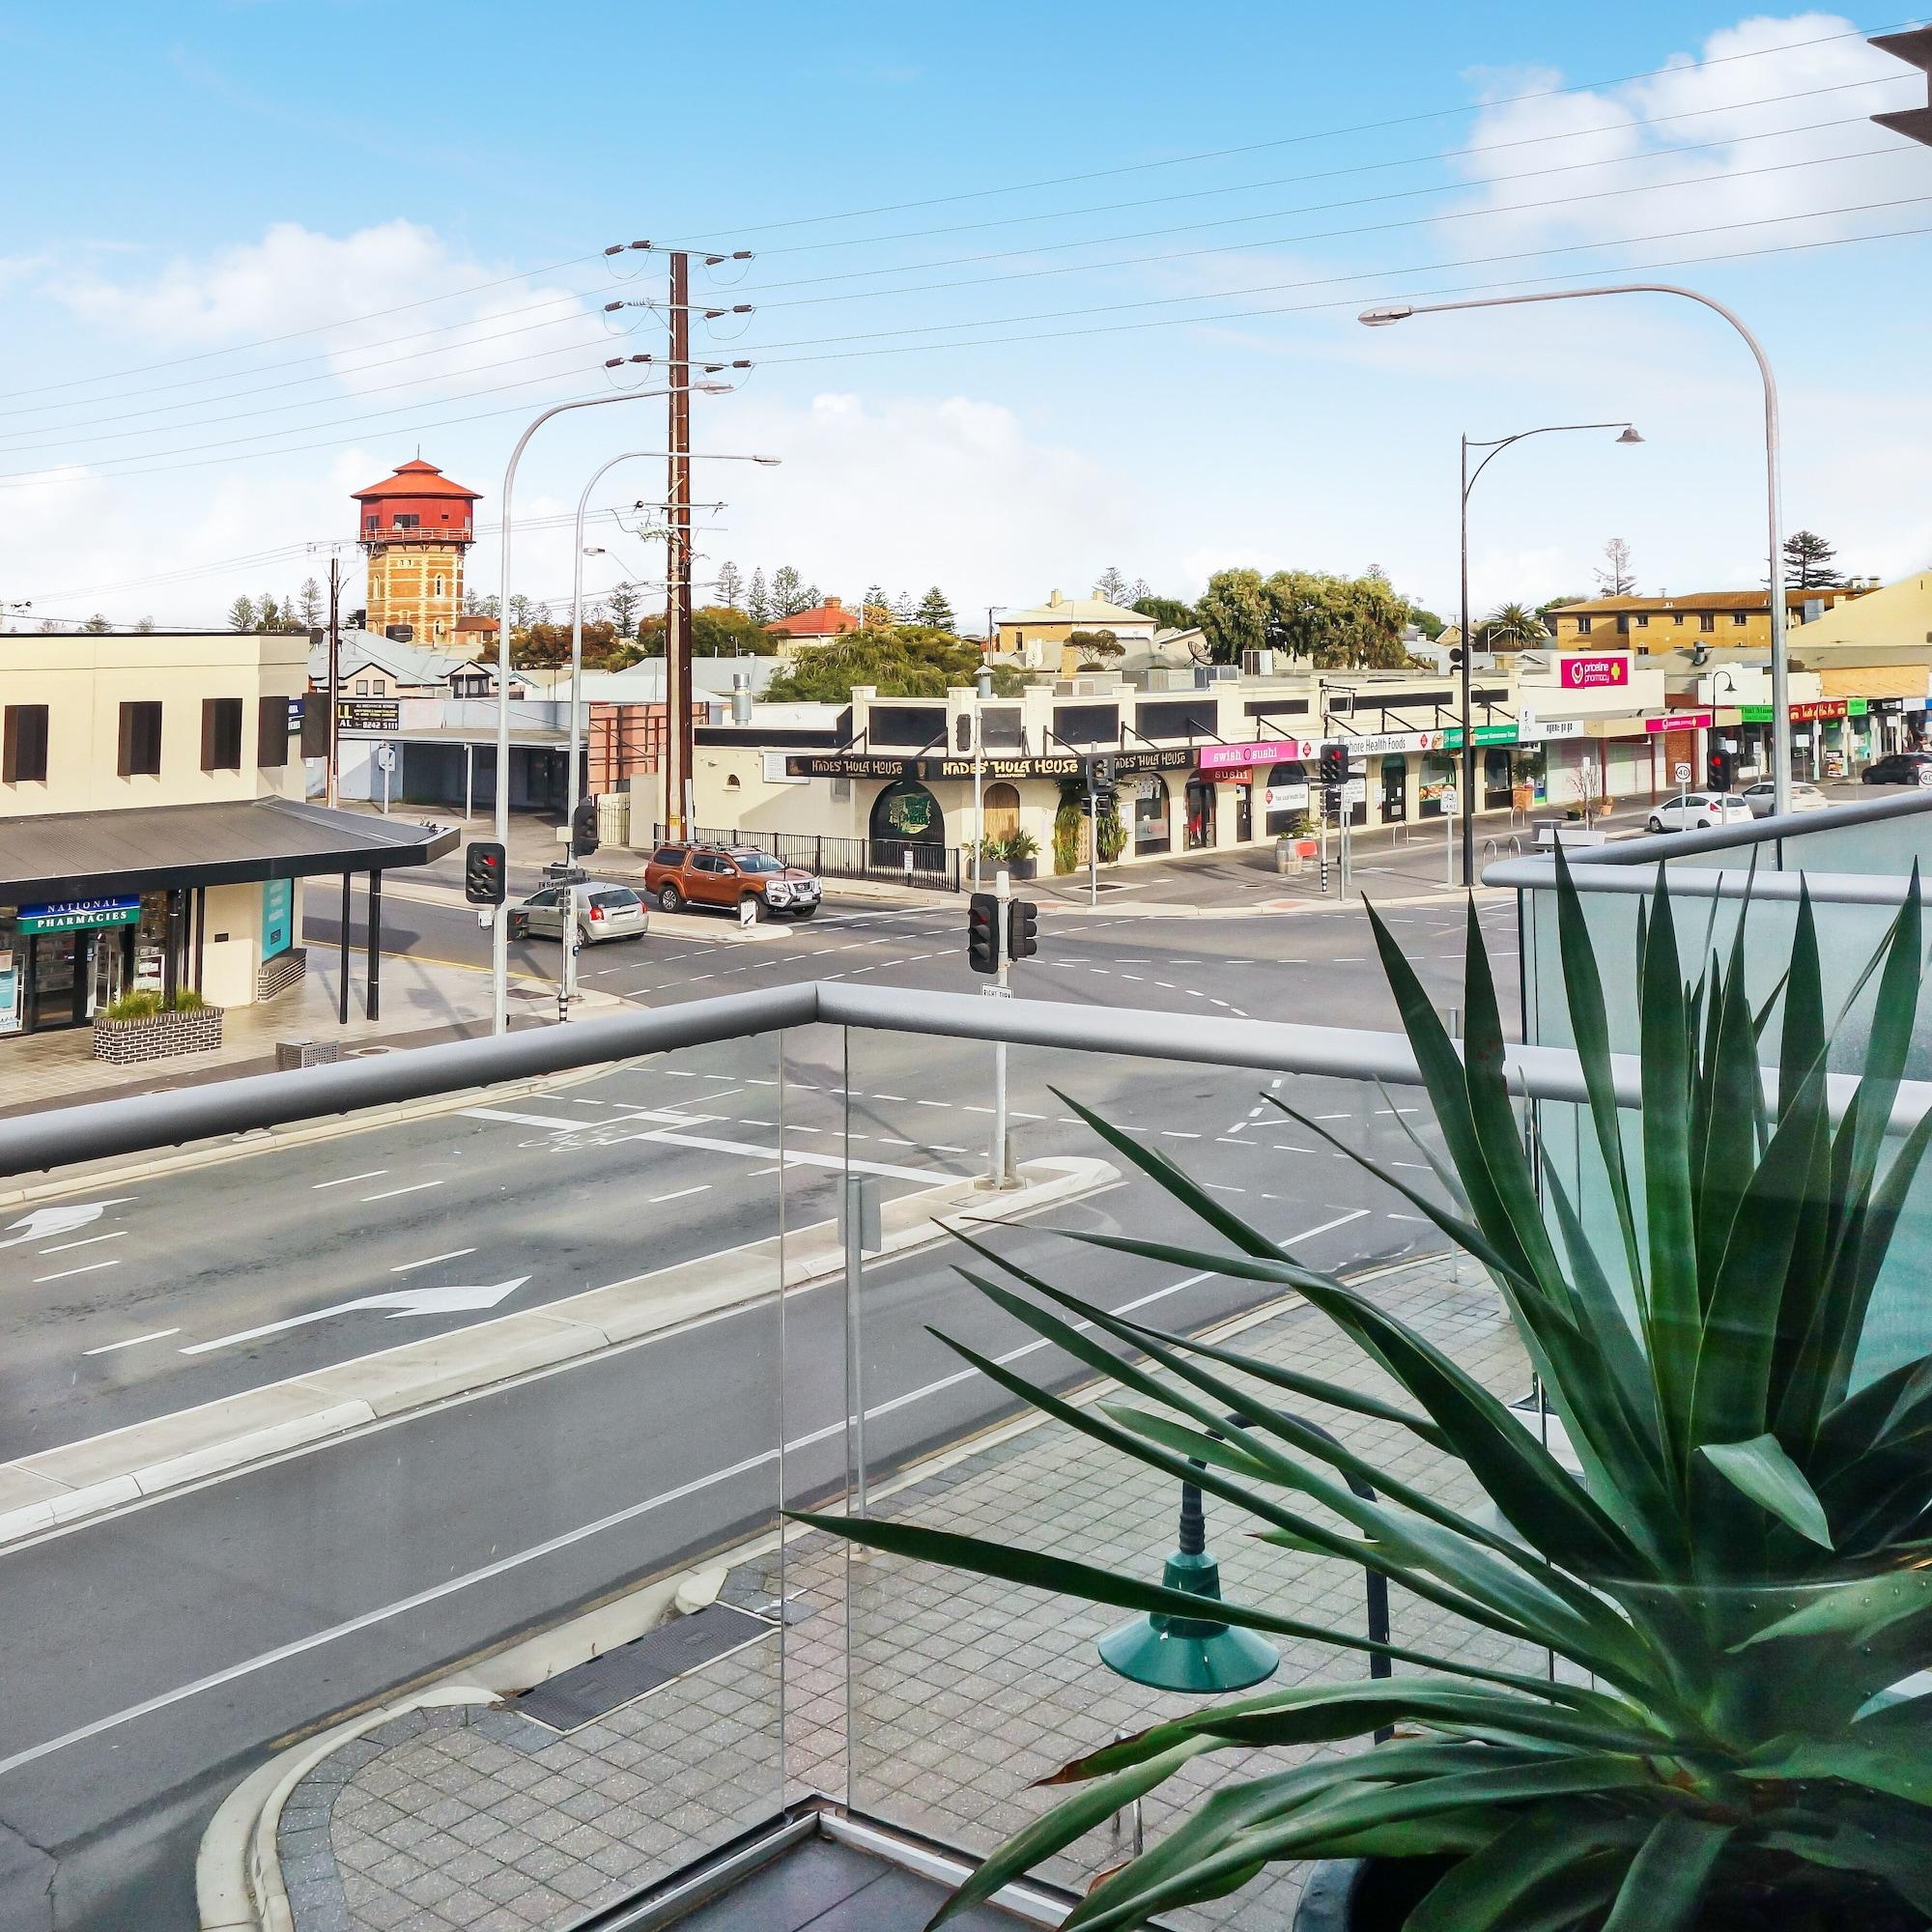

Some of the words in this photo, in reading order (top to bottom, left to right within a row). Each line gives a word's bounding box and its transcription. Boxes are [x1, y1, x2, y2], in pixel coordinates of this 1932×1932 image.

[1365, 738, 1387, 752] Health
[1388, 737, 1406, 750] Foods
[1252, 747, 1277, 760] sushi
[1214, 769, 1248, 780] sushi
[47, 898, 118, 913] NATIONAL
[37, 911, 128, 928] PHARMACIES
